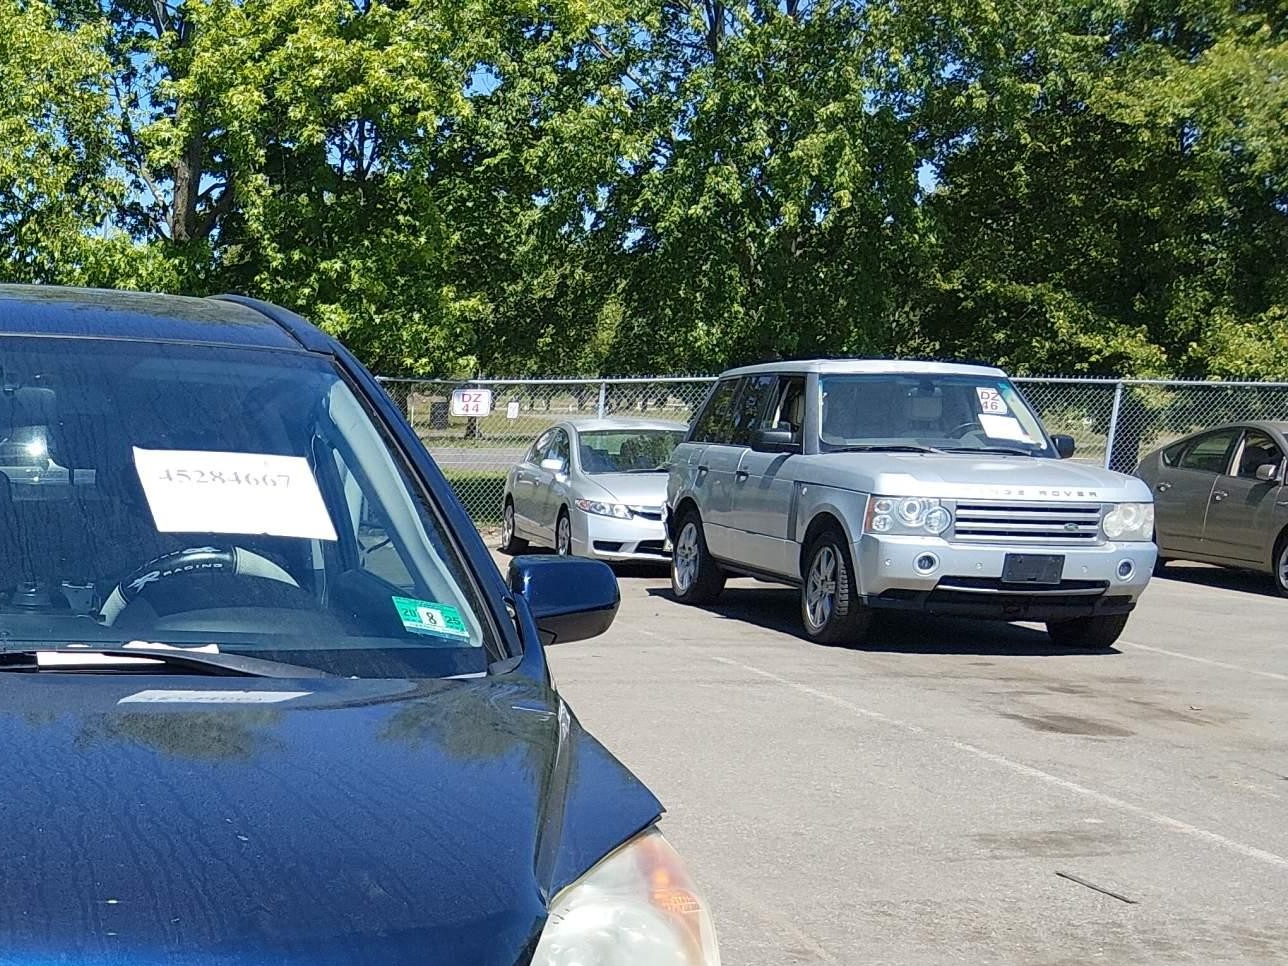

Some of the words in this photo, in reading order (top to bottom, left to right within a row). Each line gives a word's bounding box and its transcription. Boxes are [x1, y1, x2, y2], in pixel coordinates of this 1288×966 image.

[461, 393, 482, 403] DZ
[462, 403, 479, 413] 44
[1039, 489, 1098, 497] ROVER
[426, 611, 437, 625] 8
